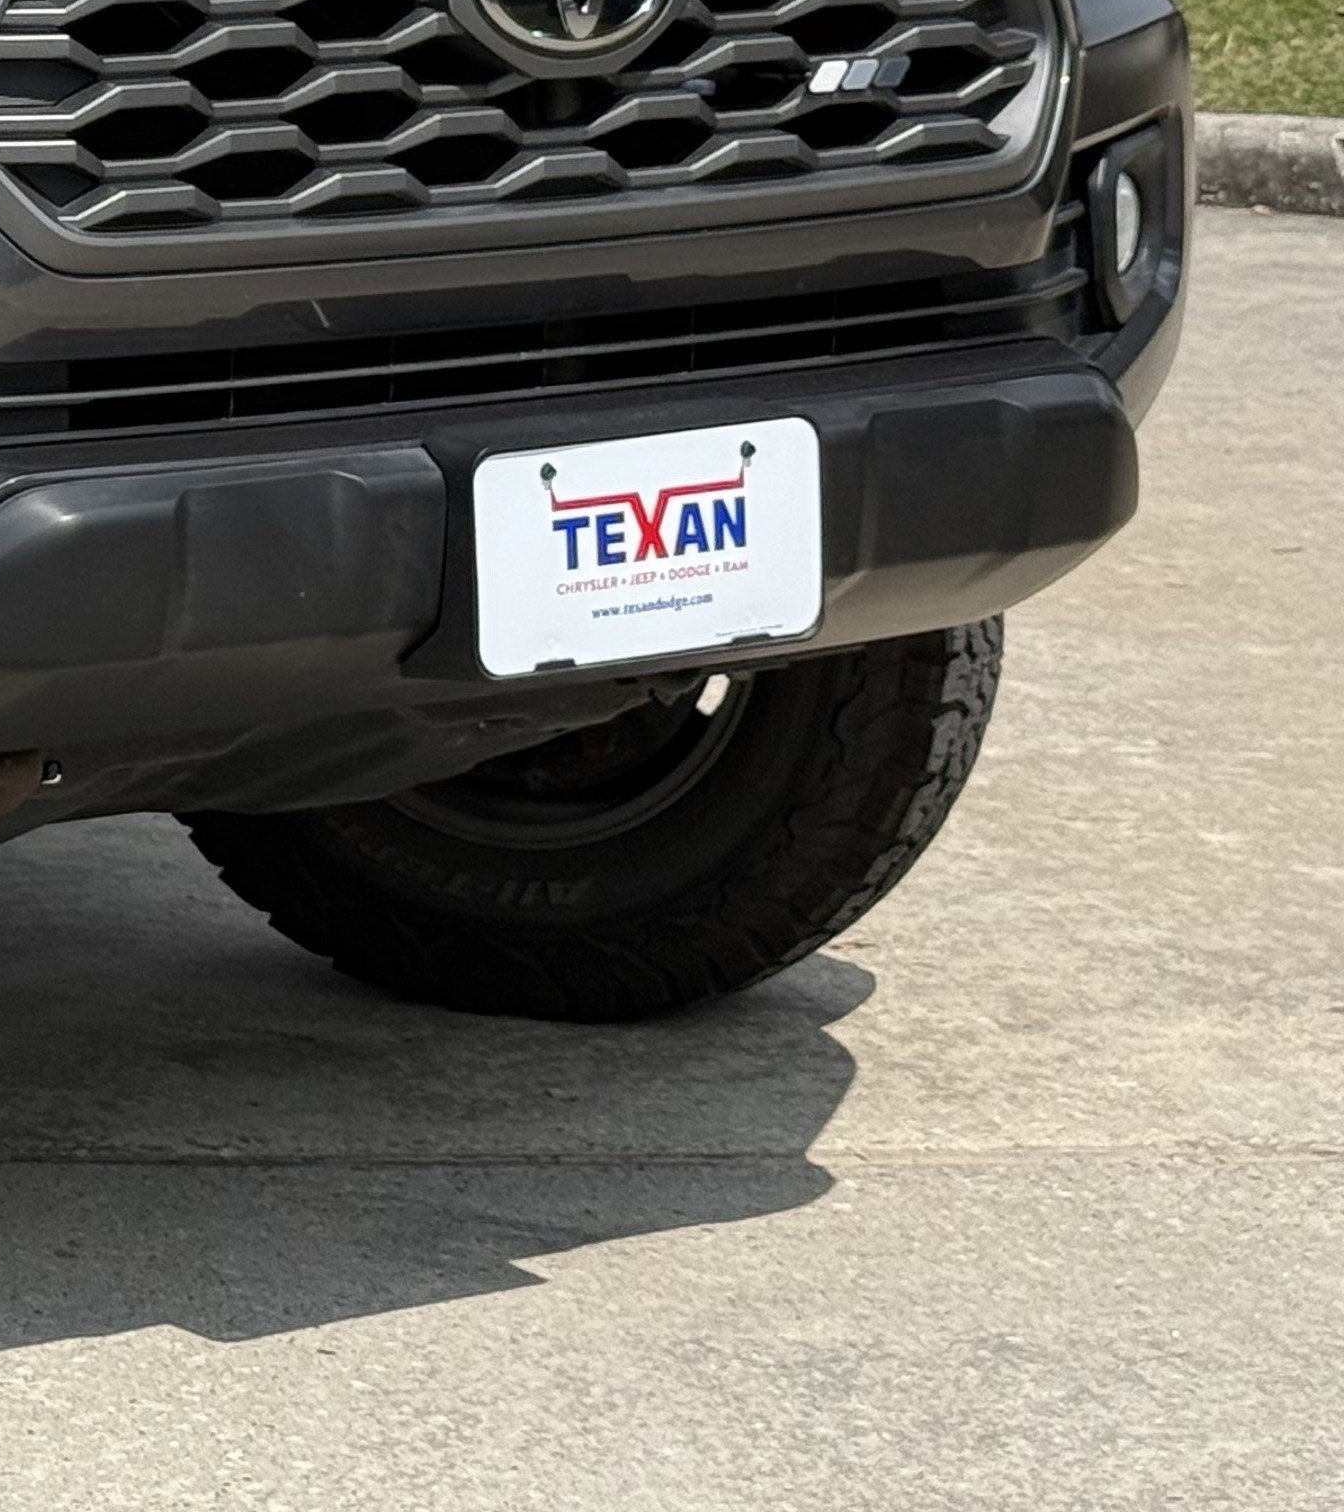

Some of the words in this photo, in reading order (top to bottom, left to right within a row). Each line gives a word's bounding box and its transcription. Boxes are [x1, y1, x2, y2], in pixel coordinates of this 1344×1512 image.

[552, 491, 748, 571] TEXAN
[555, 575, 619, 596] CHRYSLER
[628, 570, 658, 587] JEEP
[668, 563, 712, 582] DODGE
[722, 560, 749, 574] RAM
[591, 591, 714, 620] www.texandodge.com
